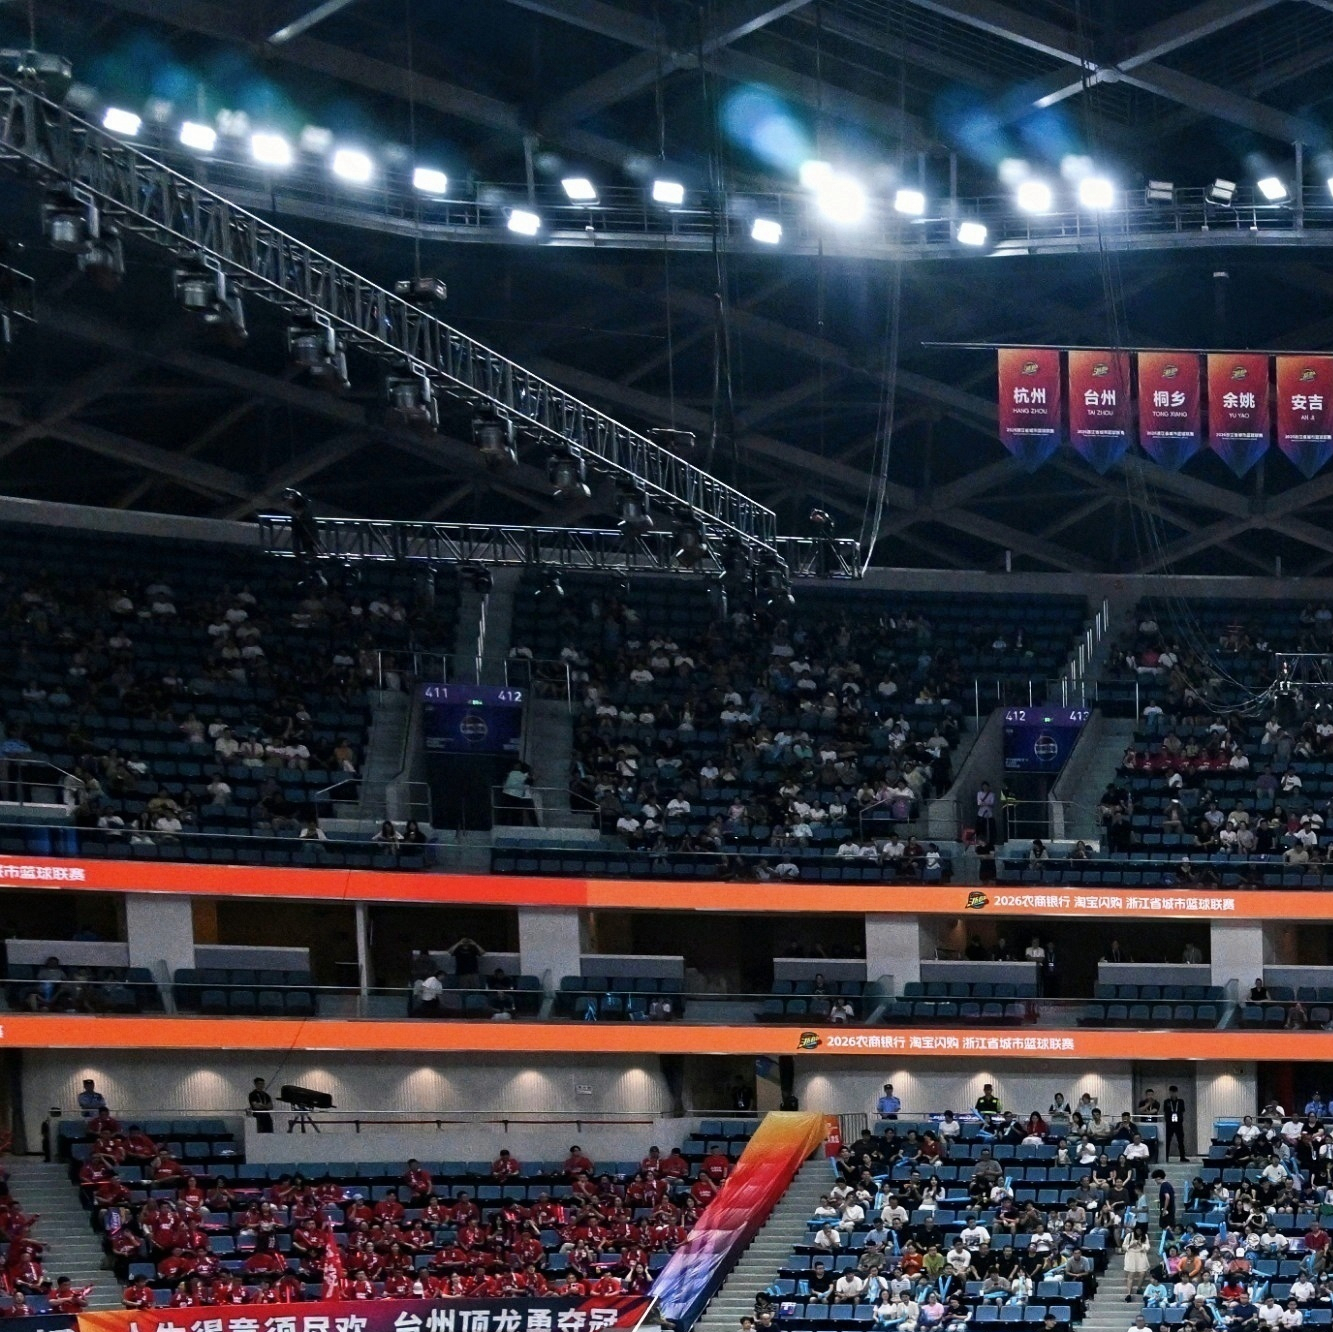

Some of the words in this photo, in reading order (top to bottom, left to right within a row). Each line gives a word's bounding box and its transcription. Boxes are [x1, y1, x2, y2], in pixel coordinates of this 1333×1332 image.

[1013, 387, 1046, 404] 杭州
[1083, 389, 1116, 406] 台州
[1153, 390, 1186, 407] 桐乡
[1223, 392, 1256, 409] 余姚
[1291, 394, 1324, 411] 安吉
[425, 687, 448, 699] 411
[498, 690, 522, 702] 412
[1005, 710, 1026, 721] 412
[1069, 711, 1089, 721] 413
[993, 895, 1071, 907] 2026农商银行
[1074, 896, 1123, 909] 淘宝闪购
[1126, 897, 1235, 911] 浙江省城市篮球联赛
[827, 1035, 905, 1047] 2026农商银行
[909, 1036, 959, 1049] 淘宝闪购
[962, 1036, 1075, 1050] 浙江省城市篮球联赛
